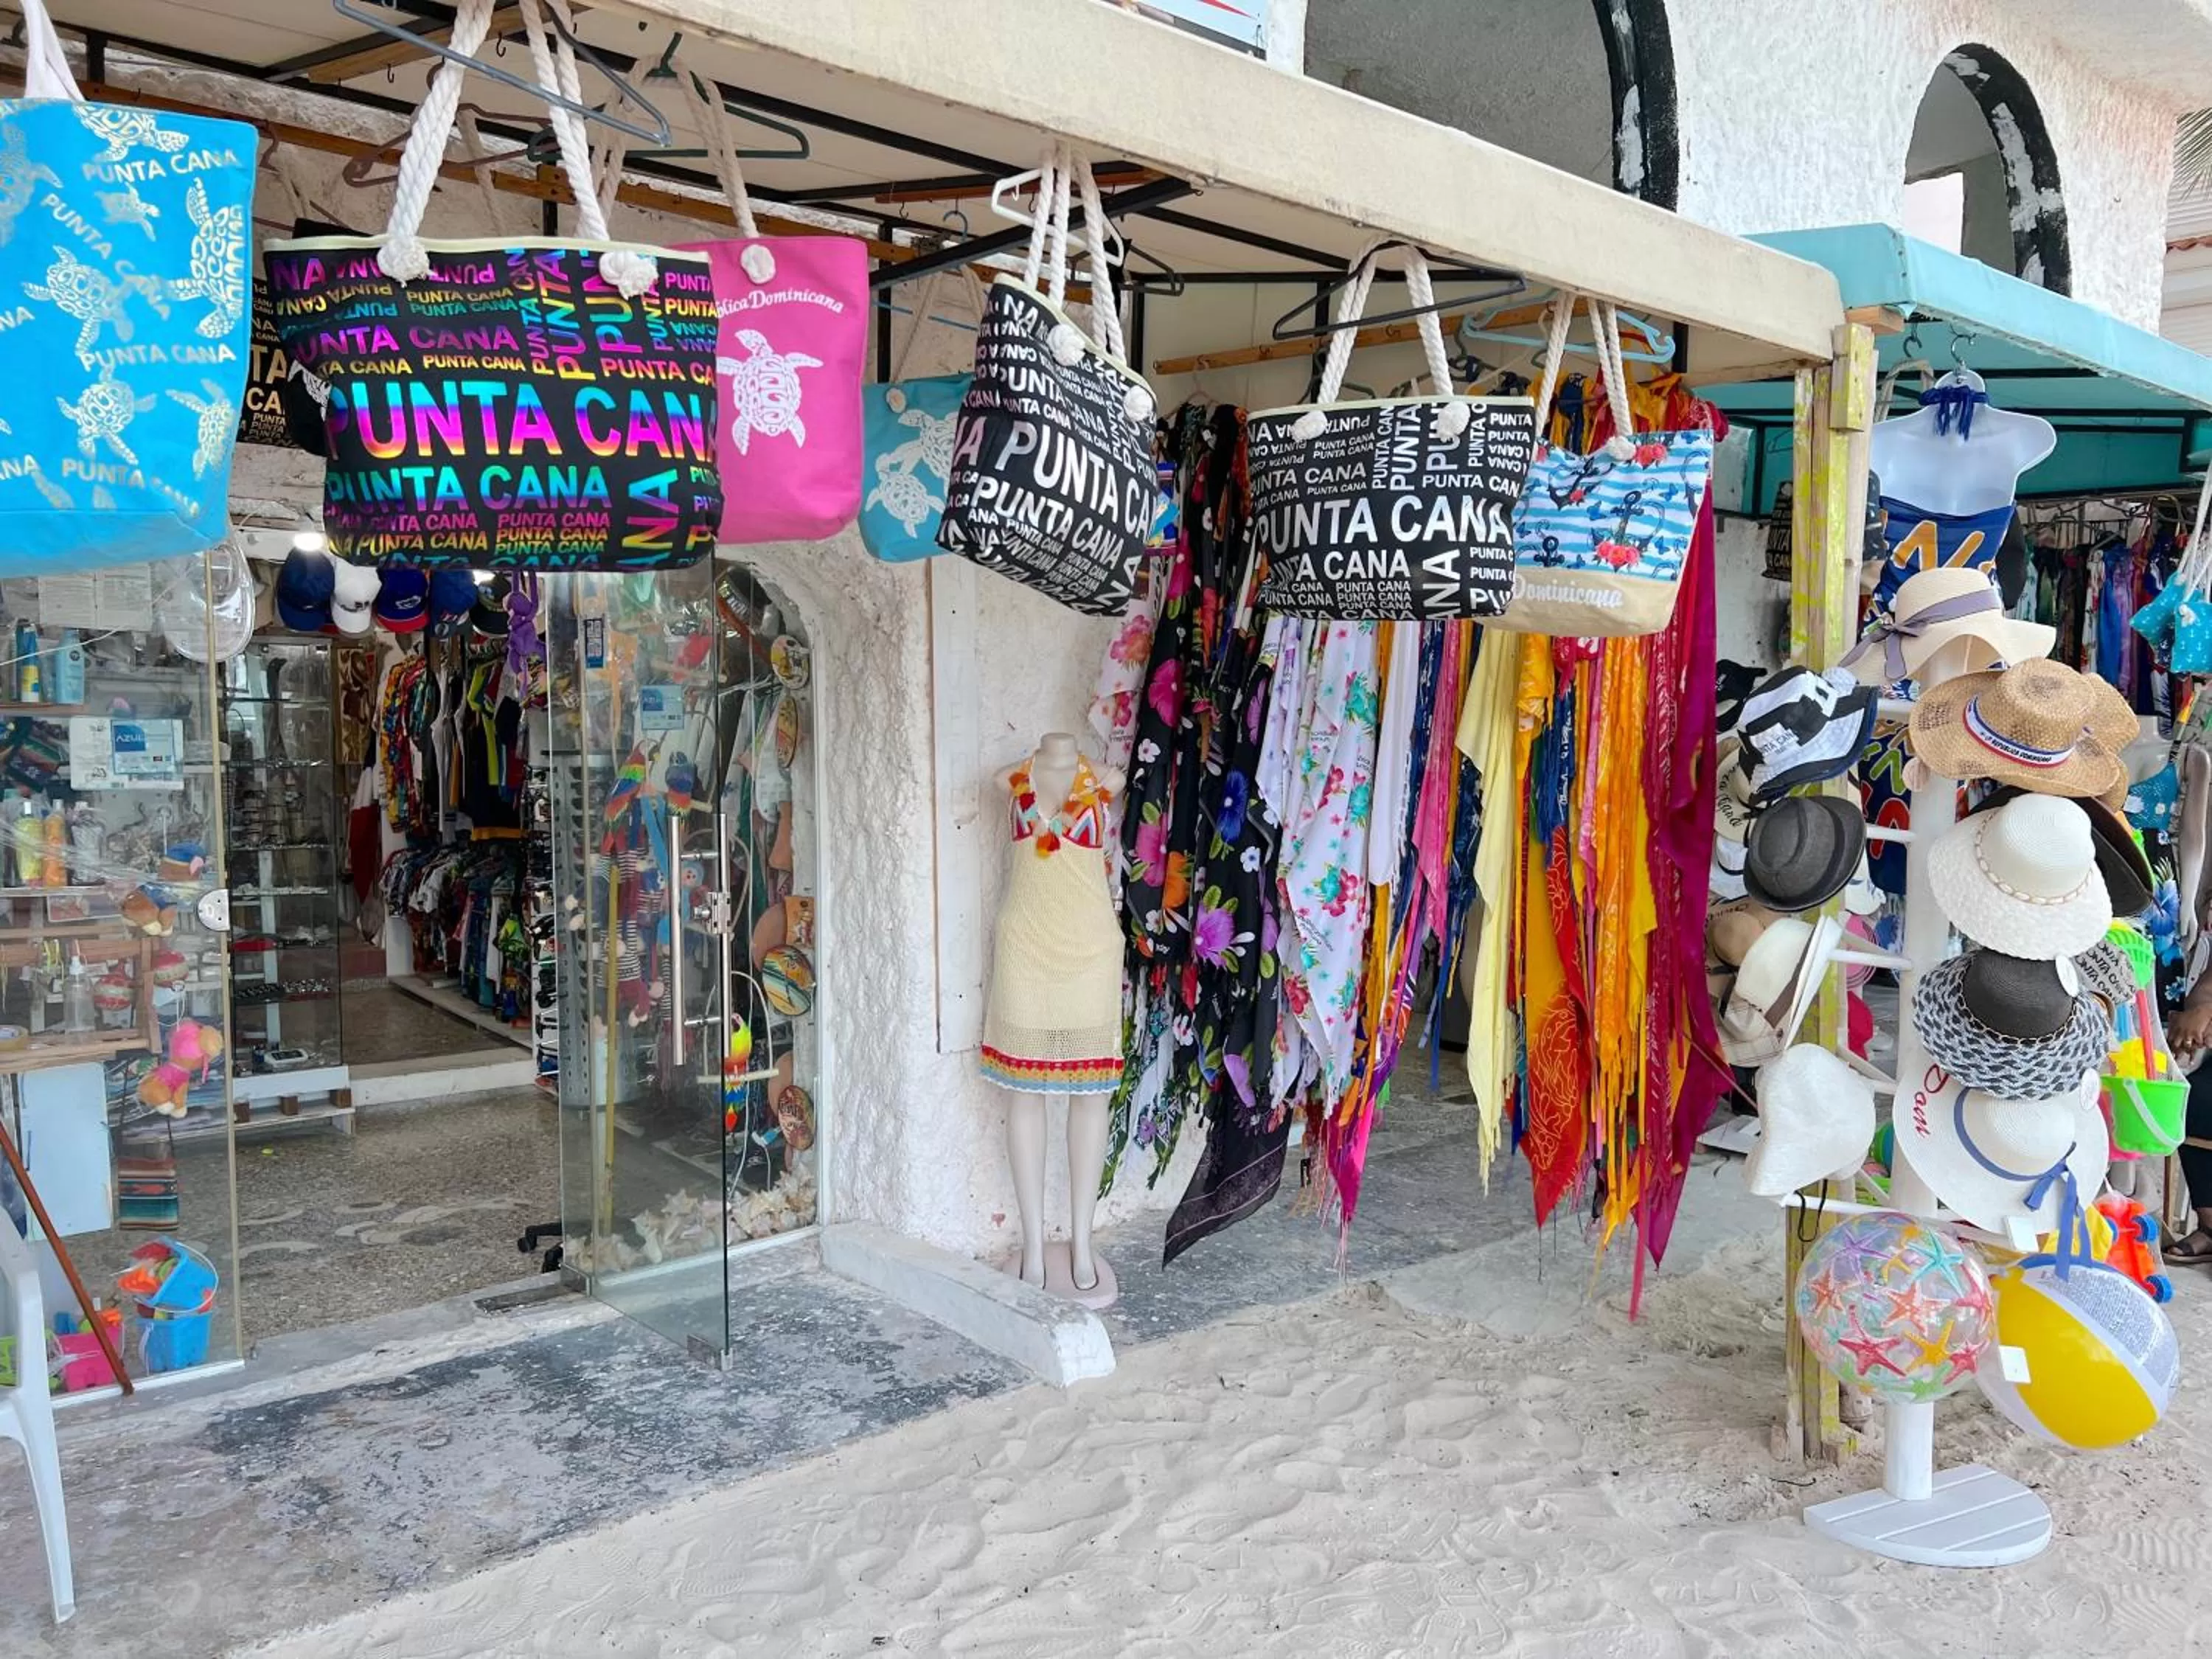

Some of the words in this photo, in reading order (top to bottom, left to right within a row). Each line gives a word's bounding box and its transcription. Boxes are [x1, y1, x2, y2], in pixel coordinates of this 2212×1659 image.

[82, 159, 167, 183] PUNTA
[171, 150, 242, 173] CANA
[40, 192, 112, 259] PUNTA
[406, 290, 464, 303] PUNTA
[466, 287, 514, 302] CANA
[748, 287, 844, 314] Dominicana
[410, 302, 467, 316] PUNTA
[469, 299, 518, 313] CANA
[533, 249, 596, 380] PUNTA
[408, 324, 519, 352] CANA
[519, 298, 555, 375] PUNTA
[78, 344, 168, 372] PUNTA
[171, 343, 237, 364] CANA
[349, 358, 414, 375] CANA
[422, 355, 479, 369] PUNTA
[481, 356, 526, 372] CANA
[600, 358, 686, 382] PUNTA
[329, 380, 562, 461] PUNTA
[1043, 403, 1071, 430] CANA
[1490, 413, 1533, 426] PUNTA
[1315, 439, 1347, 450] PUNTA
[1349, 432, 1375, 446] CANA
[1390, 403, 1422, 490] PUNTA
[1468, 417, 1486, 467] PUNTA
[1488, 431, 1531, 442] PUNTA
[1313, 449, 1346, 459] PUNTA
[1348, 442, 1374, 455] CANA
[62, 457, 146, 489] PUNTA
[995, 420, 1119, 523] PUNTA
[1304, 462, 1367, 484] CANA
[1372, 437, 1391, 490] PUNTA
[326, 465, 470, 514] PUNTA
[479, 465, 613, 509] CANA
[1307, 486, 1338, 495] PUNTA
[1340, 481, 1368, 493] CANA
[1422, 474, 1484, 488] PUNTA
[1270, 489, 1300, 504] CANA
[425, 513, 478, 530] CANA
[498, 513, 557, 528] PUNTA
[562, 512, 611, 527] CANA
[970, 476, 1074, 542] PUNTA
[1071, 518, 1124, 569] CANA
[1256, 498, 1378, 554] PUNTA
[1391, 495, 1513, 545] CANA
[496, 528, 553, 542] PUNTA
[560, 527, 608, 540] CANA
[1006, 518, 1043, 546] PUNTA
[357, 534, 424, 555] PUNTA
[430, 531, 488, 550] CANA
[494, 540, 552, 554] PUNTA
[557, 540, 606, 553] CANA
[1470, 546, 1506, 560] PUNTA
[1324, 549, 1411, 580] CANA
[1470, 566, 1506, 580] PUNTA
[1291, 582, 1324, 593] CANA
[1335, 581, 1374, 592] PUNTA
[1377, 580, 1411, 592] CANA
[1298, 593, 1335, 606] CANA
[1337, 592, 1376, 602] PUNTA
[1378, 592, 1412, 602] CANA
[1338, 601, 1377, 610] PUNTA
[1380, 601, 1413, 610] CANA
